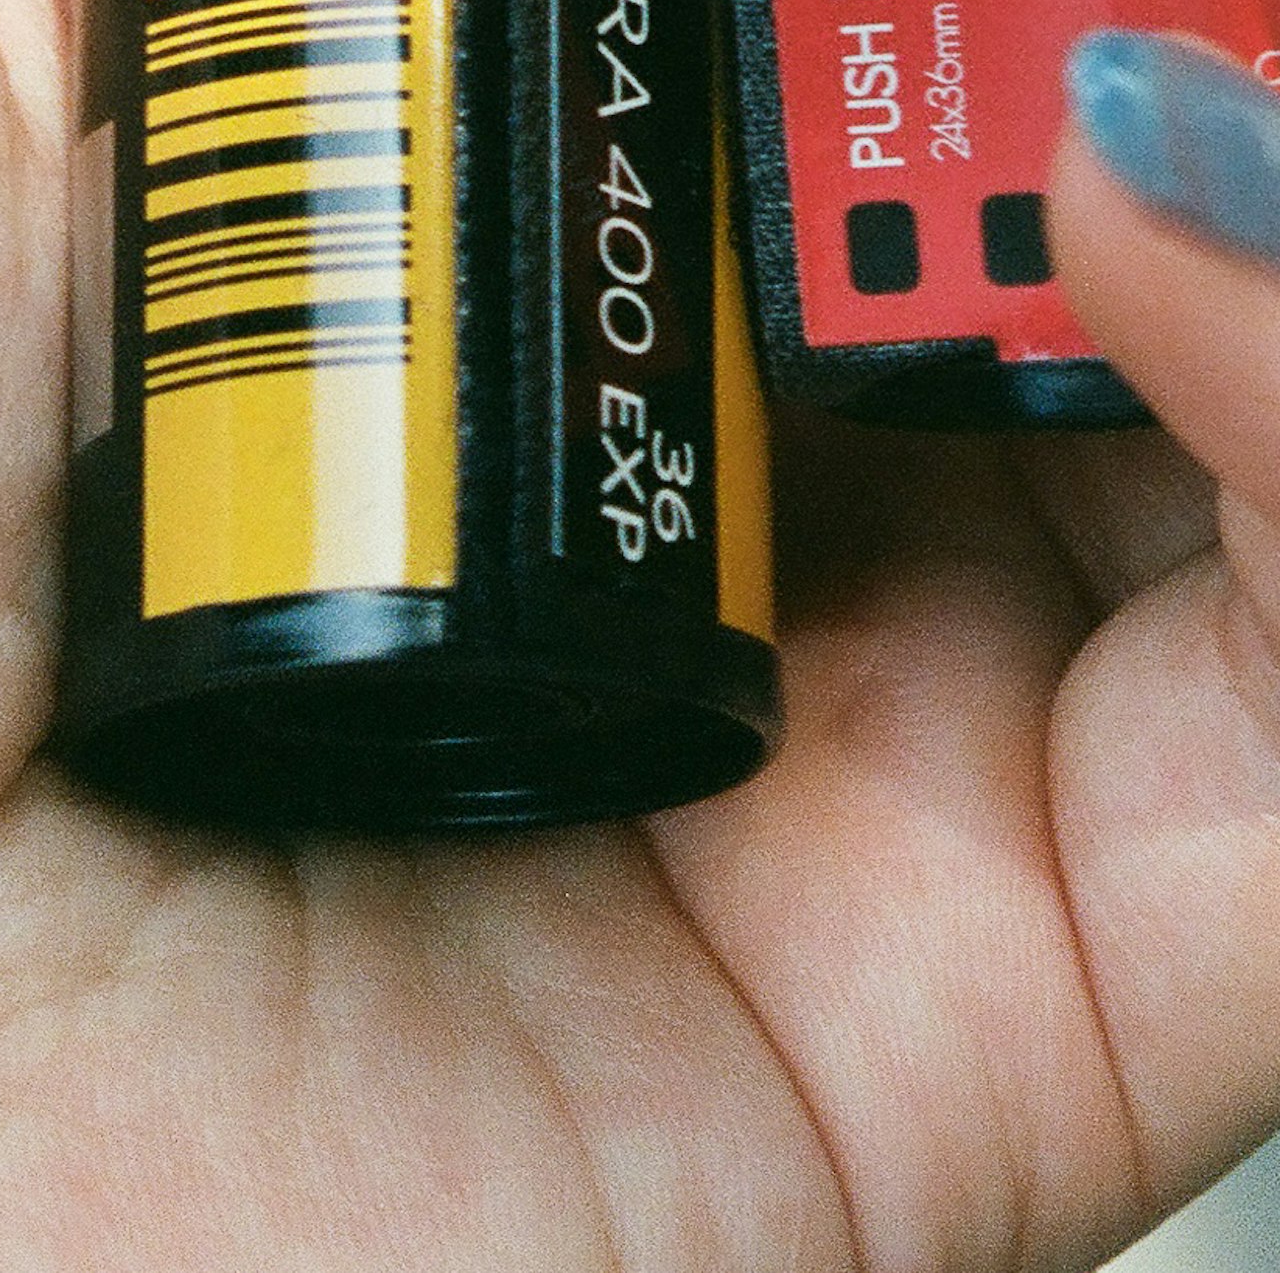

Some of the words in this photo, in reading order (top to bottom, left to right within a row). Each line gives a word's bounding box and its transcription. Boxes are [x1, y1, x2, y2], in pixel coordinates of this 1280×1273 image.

[838, 22, 905, 168] PUSH
[924, 1, 972, 162] 24x36mm
[597, 143, 655, 356] 400
[599, 382, 648, 563] EXP
[651, 429, 697, 544] 36
